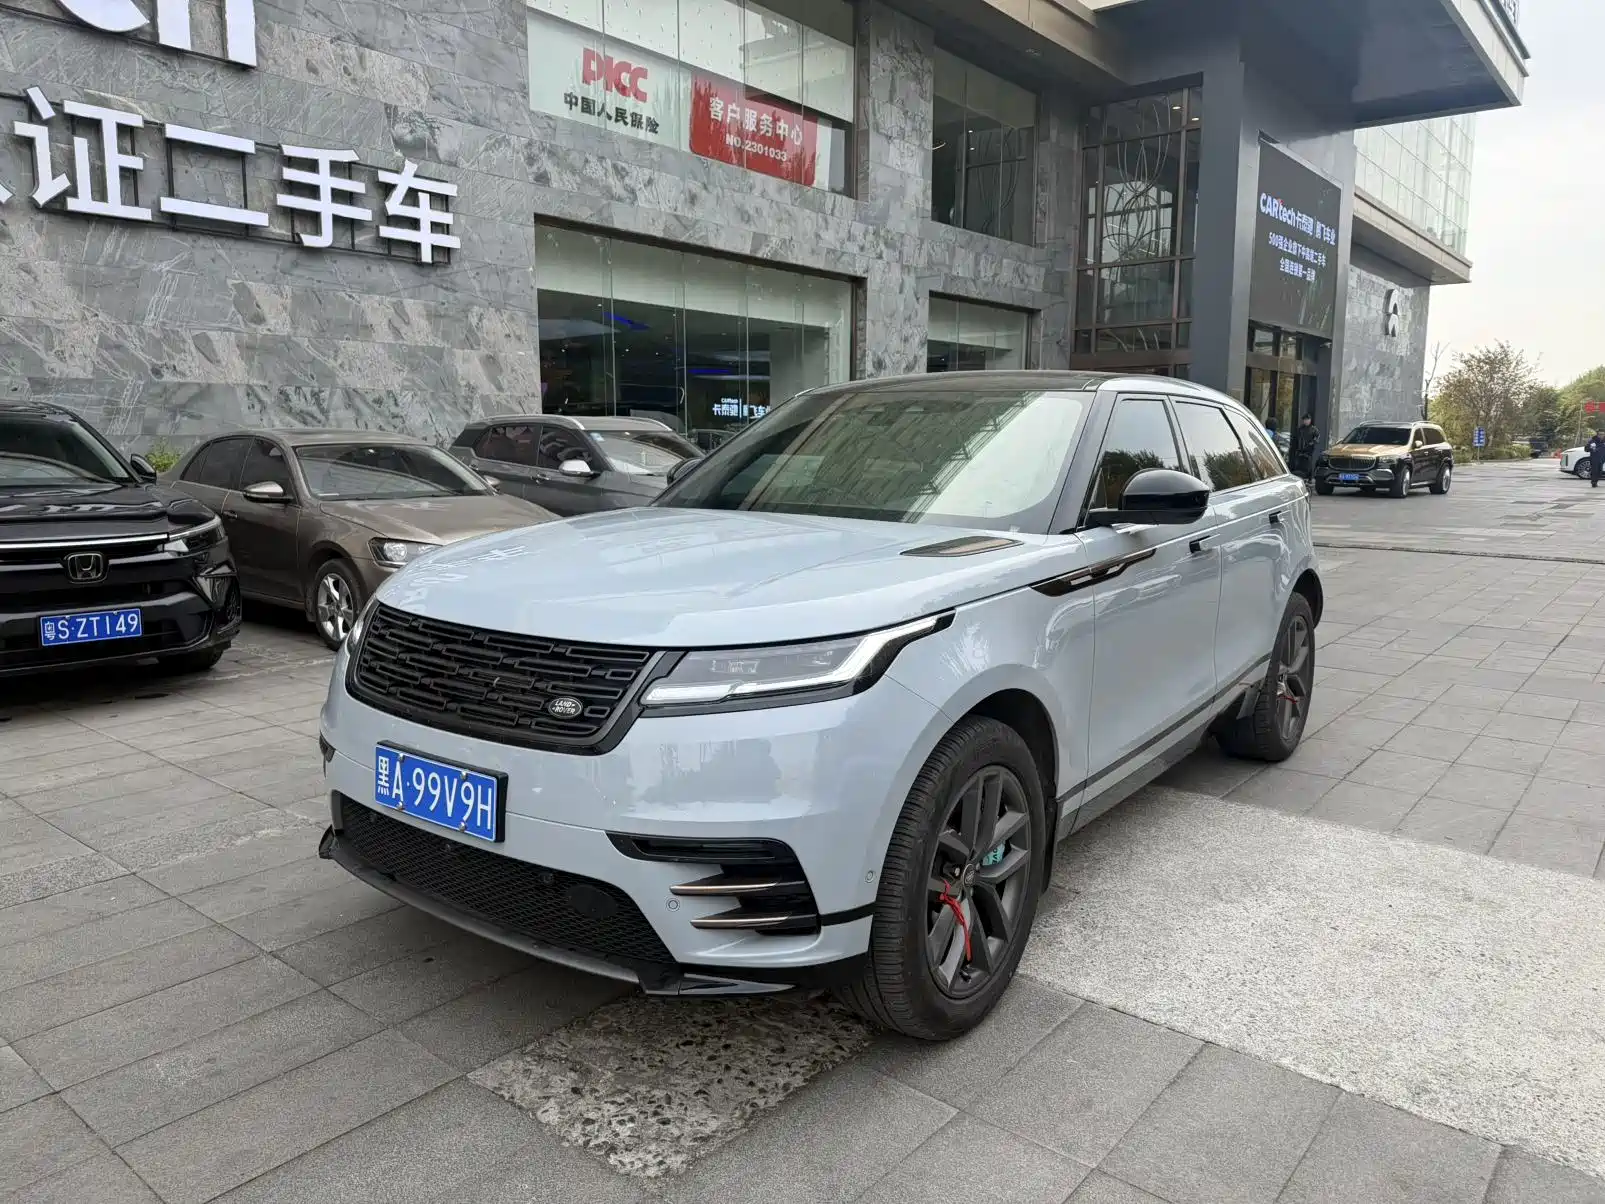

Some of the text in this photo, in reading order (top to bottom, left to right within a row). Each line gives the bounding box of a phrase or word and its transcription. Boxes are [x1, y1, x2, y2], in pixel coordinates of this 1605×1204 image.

[582, 47, 648, 103] PICC
[563, 92, 660, 134] 中国人民保险
[709, 97, 803, 145] 客户服务中心
[725, 133, 788, 161] NO.2301033
[0, 86, 461, 264] 证二手车
